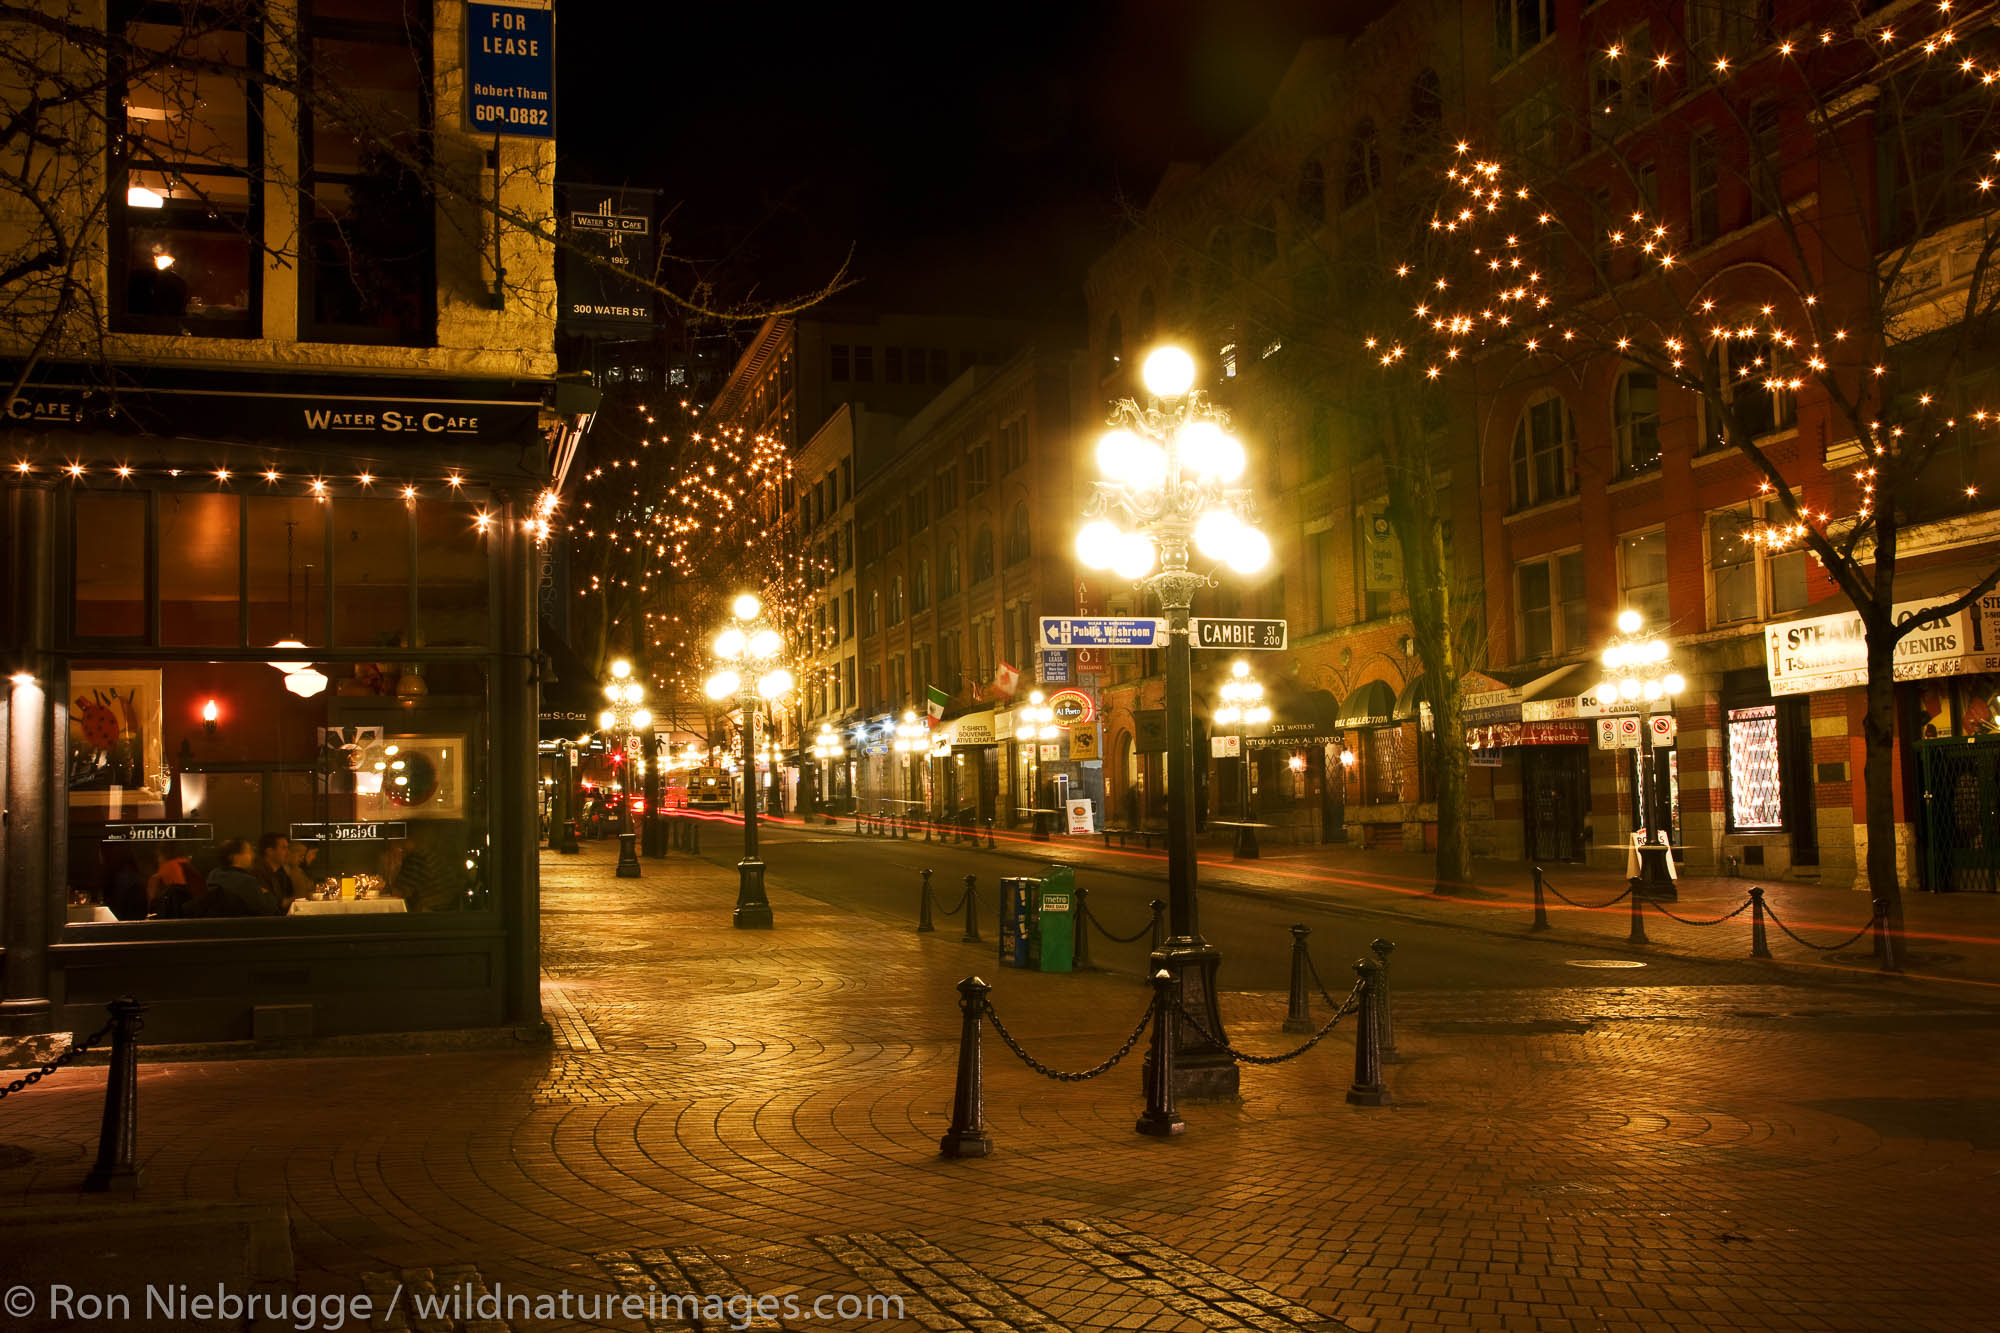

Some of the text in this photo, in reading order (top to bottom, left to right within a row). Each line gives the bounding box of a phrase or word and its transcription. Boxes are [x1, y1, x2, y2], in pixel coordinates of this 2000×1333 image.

[491, 12, 526, 31] FOR
[482, 36, 539, 57] LEASE
[474, 83, 548, 101] Robert Tham
[475, 104, 548, 126] 609.0882
[573, 304, 648, 317] 300 WATER ST.
[7, 398, 72, 420] CAFE
[304, 409, 376, 430] WATER
[422, 413, 479, 433] CAFE
[1073, 625, 1150, 637] Public Washroom
[1204, 624, 1276, 643] CAMBIE ST
[1263, 636, 1280, 646] 200
[1473, 692, 1505, 705] CENTRE
[1271, 725, 1285, 734] 321
[1314, 735, 1341, 744] PORTO
